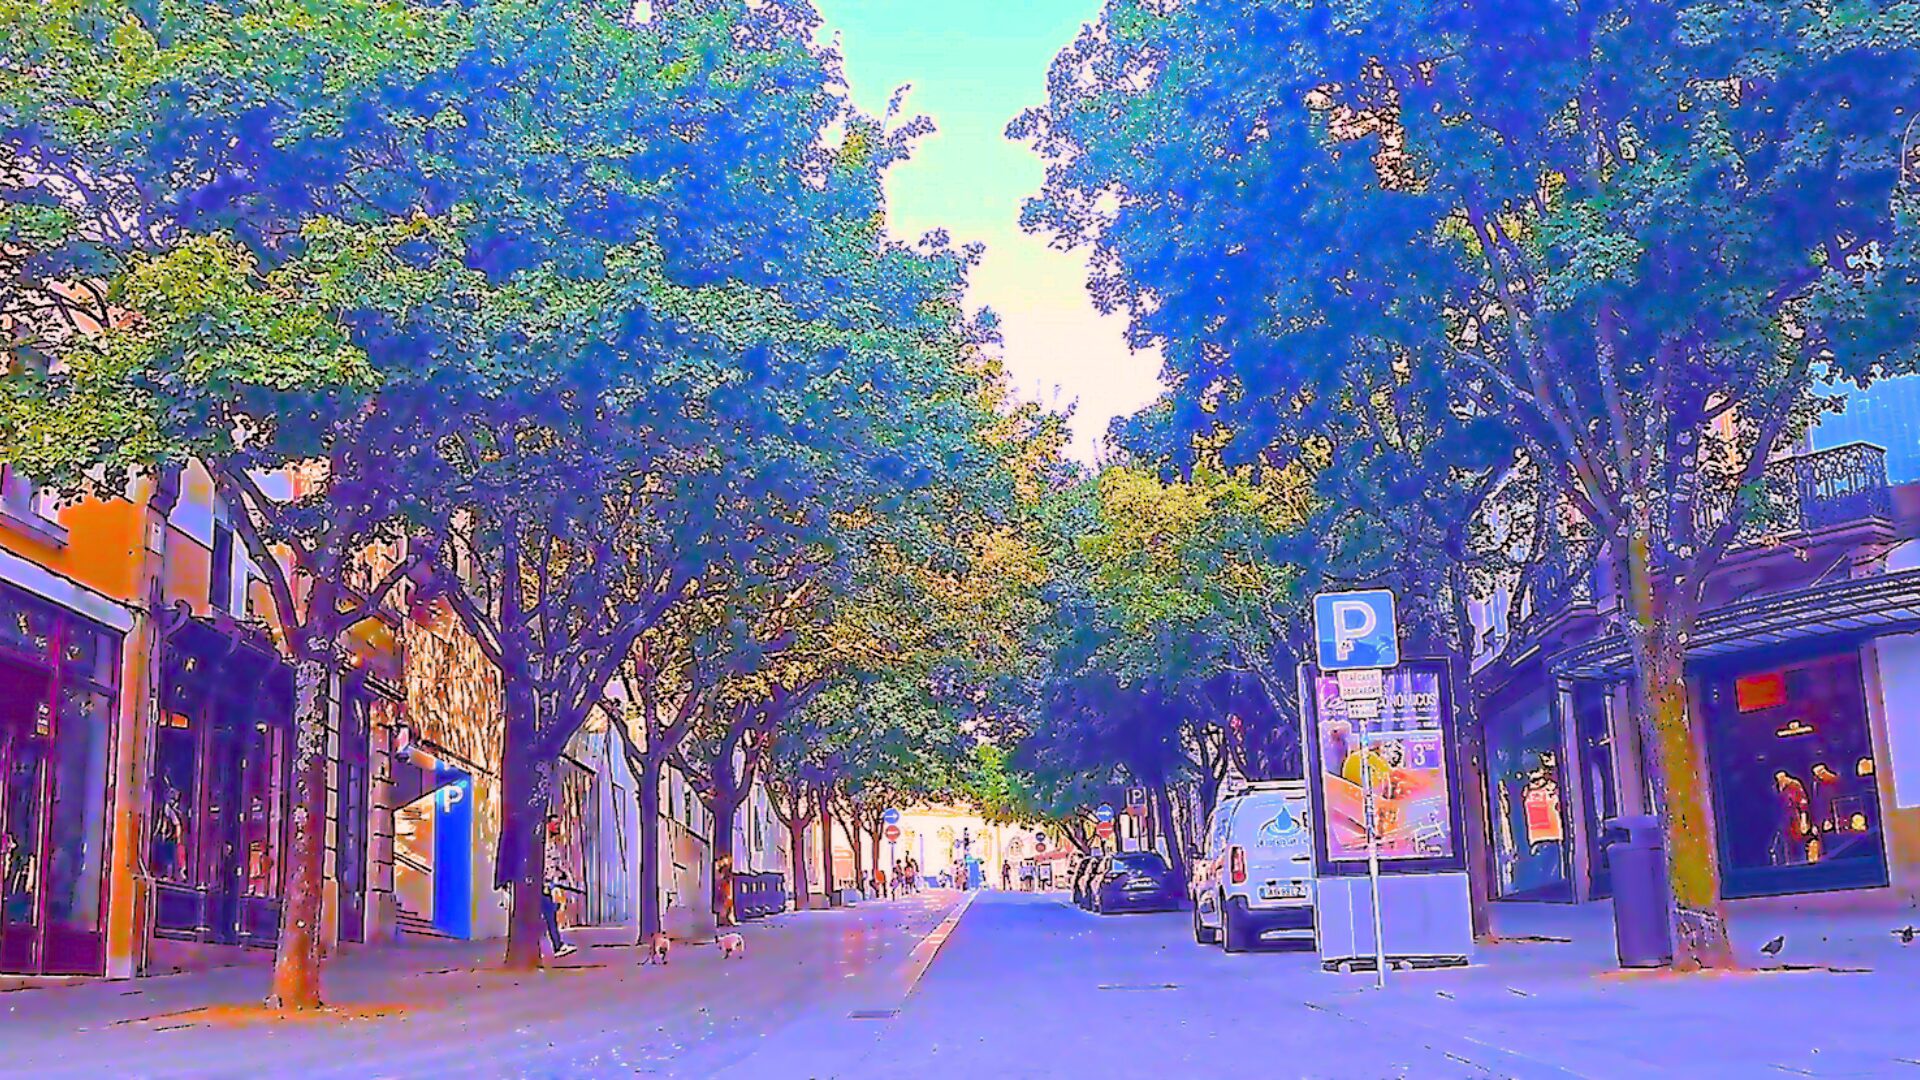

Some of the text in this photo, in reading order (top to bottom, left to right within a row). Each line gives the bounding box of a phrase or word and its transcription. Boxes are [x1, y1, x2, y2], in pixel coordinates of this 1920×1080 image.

[1333, 601, 1377, 661] P
[444, 785, 463, 813] P
[1132, 789, 1142, 804] P
